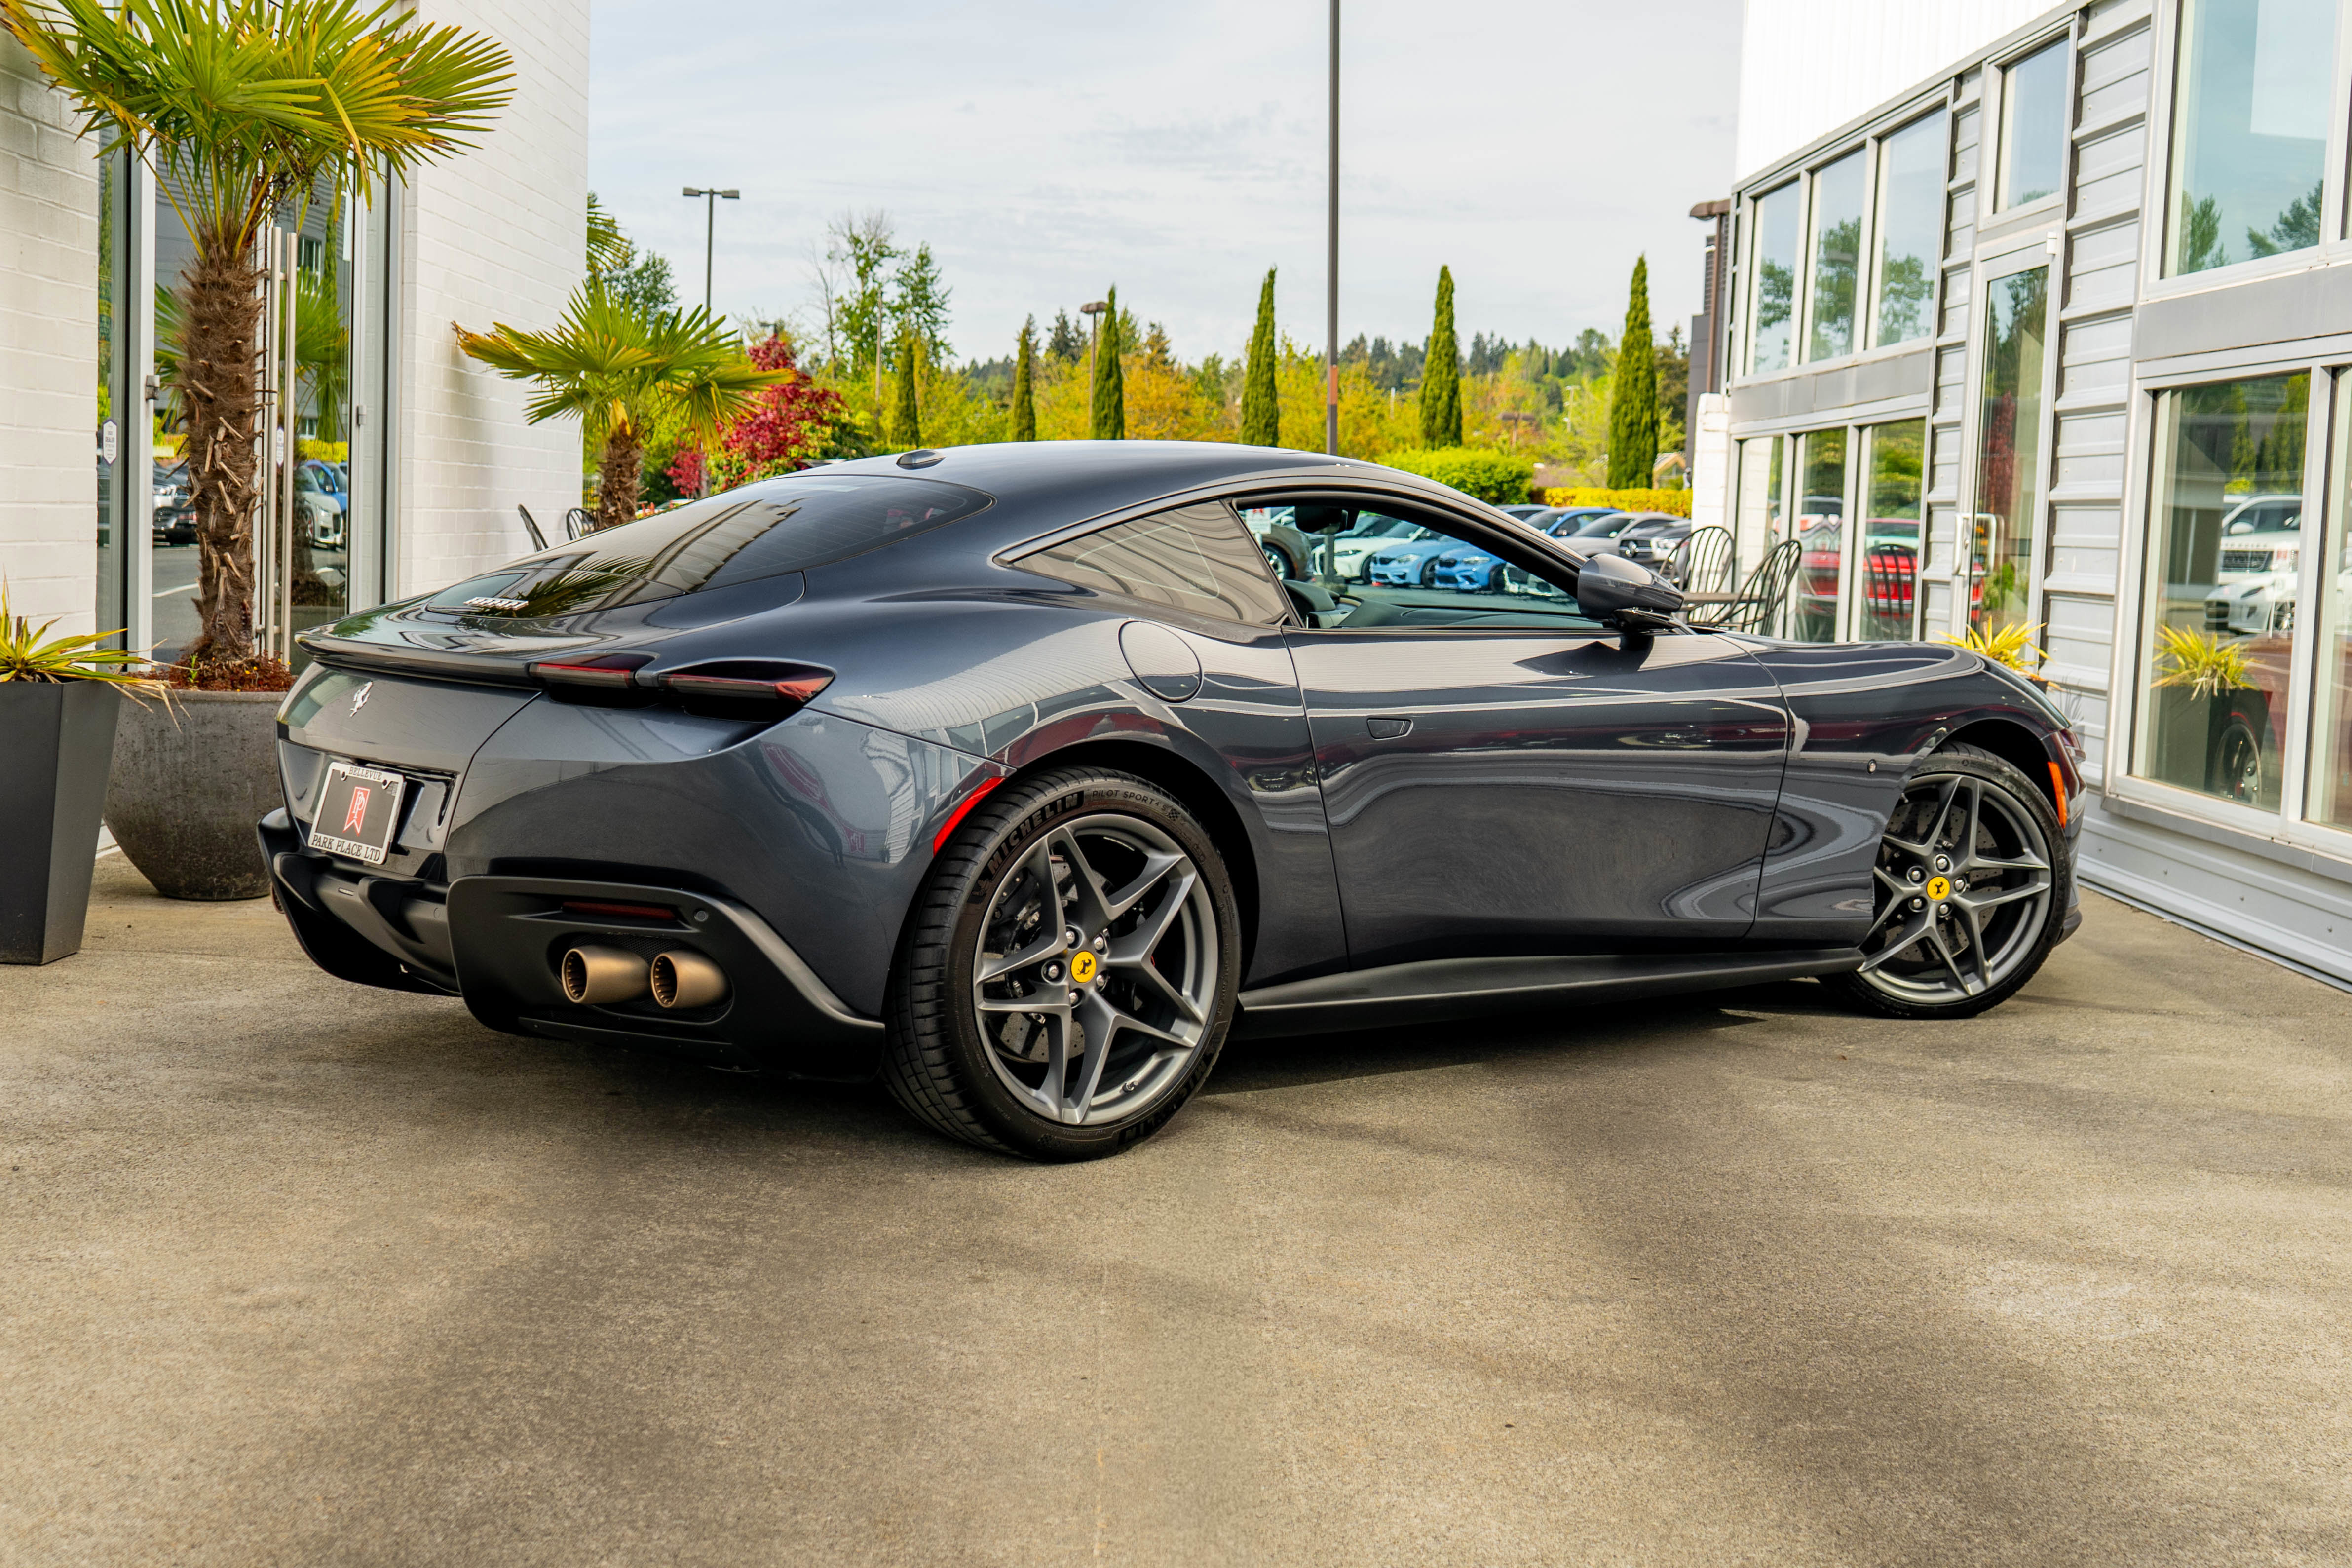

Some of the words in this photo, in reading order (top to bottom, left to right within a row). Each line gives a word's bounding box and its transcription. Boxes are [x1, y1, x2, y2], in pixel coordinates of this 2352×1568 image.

[348, 766, 382, 780] BELLEVUE
[1123, 791, 1155, 805] SPORT
[987, 793, 1078, 875] MICHELIN
[311, 834, 334, 849] PARK
[335, 840, 362, 857] PLACE
[364, 847, 381, 861] LTD
